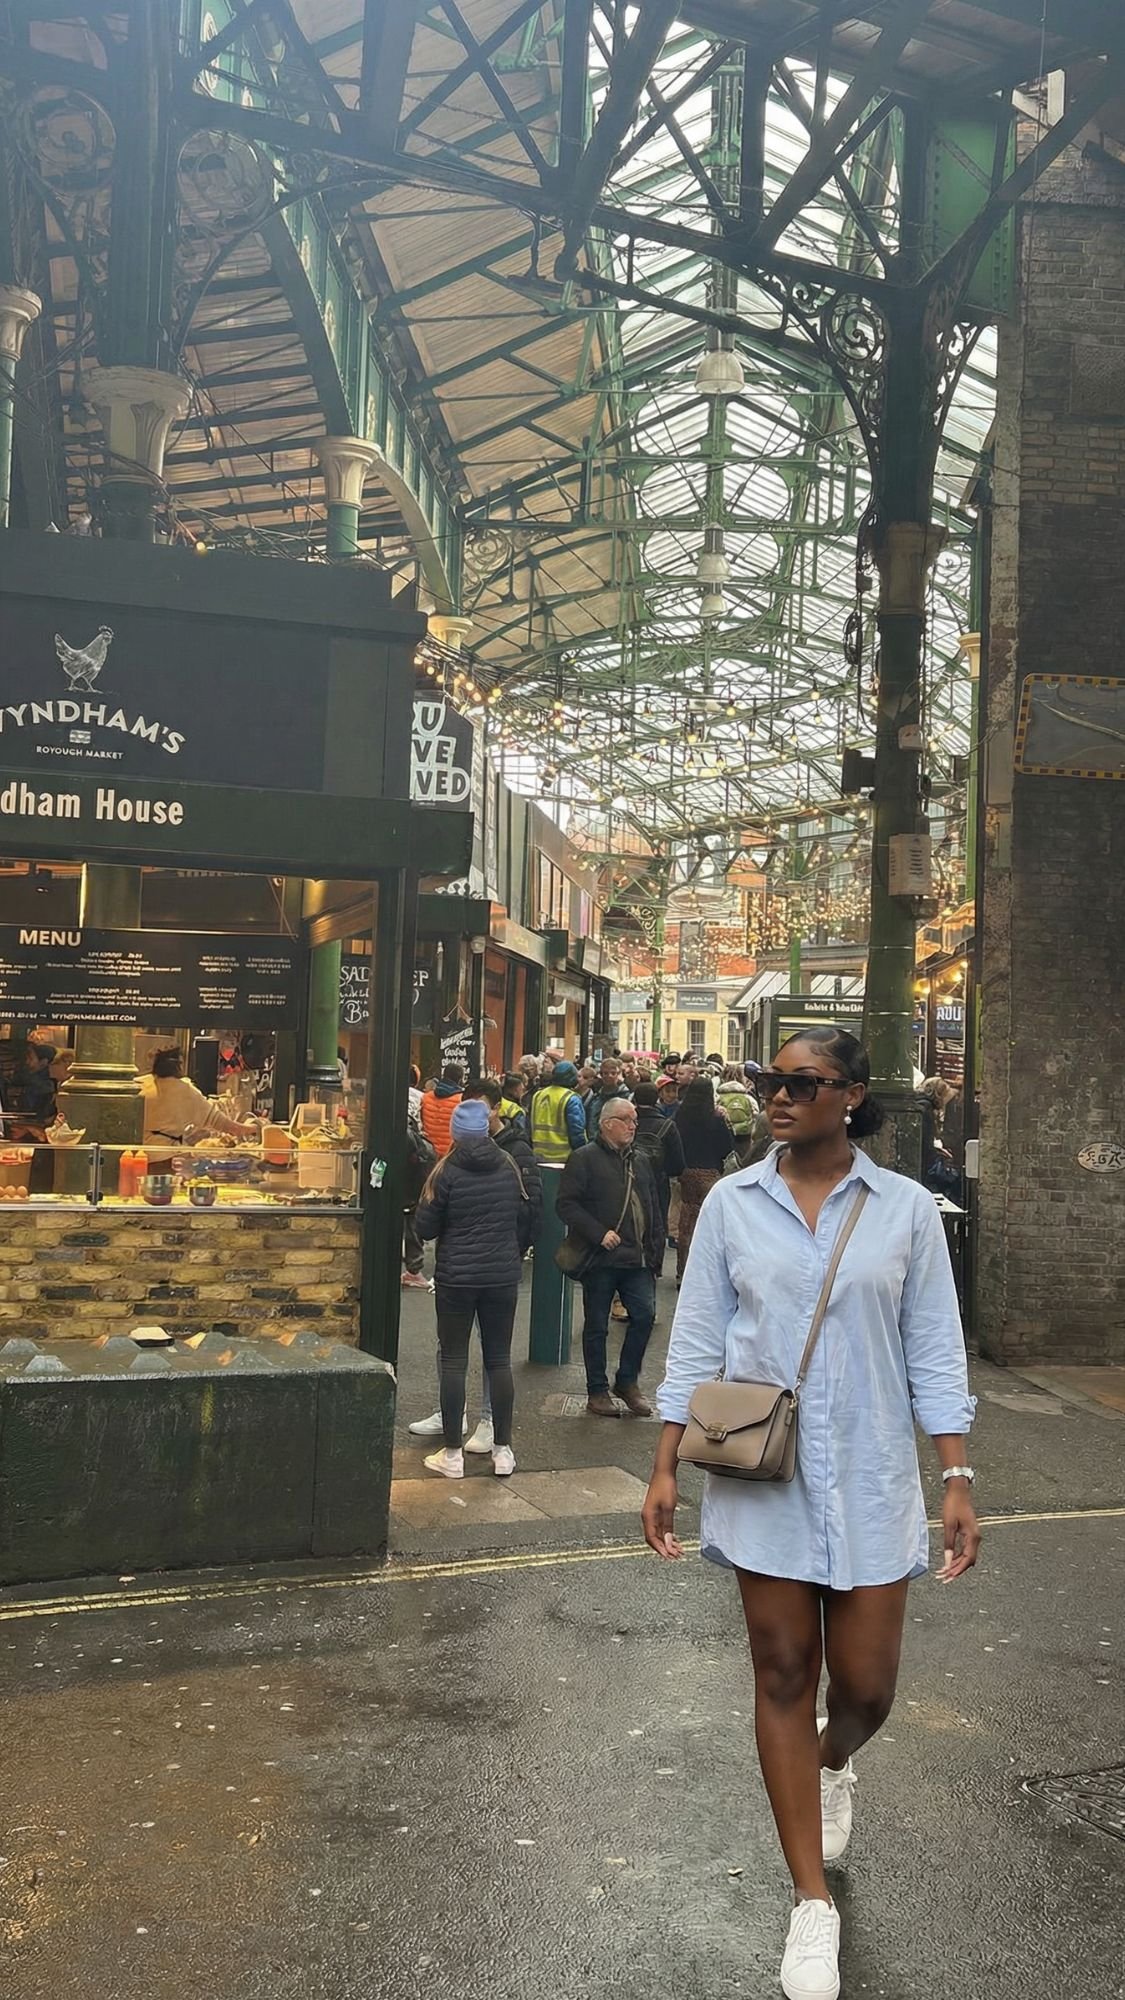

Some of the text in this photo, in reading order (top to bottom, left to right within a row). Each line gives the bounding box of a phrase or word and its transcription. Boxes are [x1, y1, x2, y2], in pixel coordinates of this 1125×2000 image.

[0, 700, 186, 754] YNDHAM'S
[86, 750, 124, 760] MARKET
[0, 782, 184, 825] dham House
[19, 929, 82, 946] MENU
